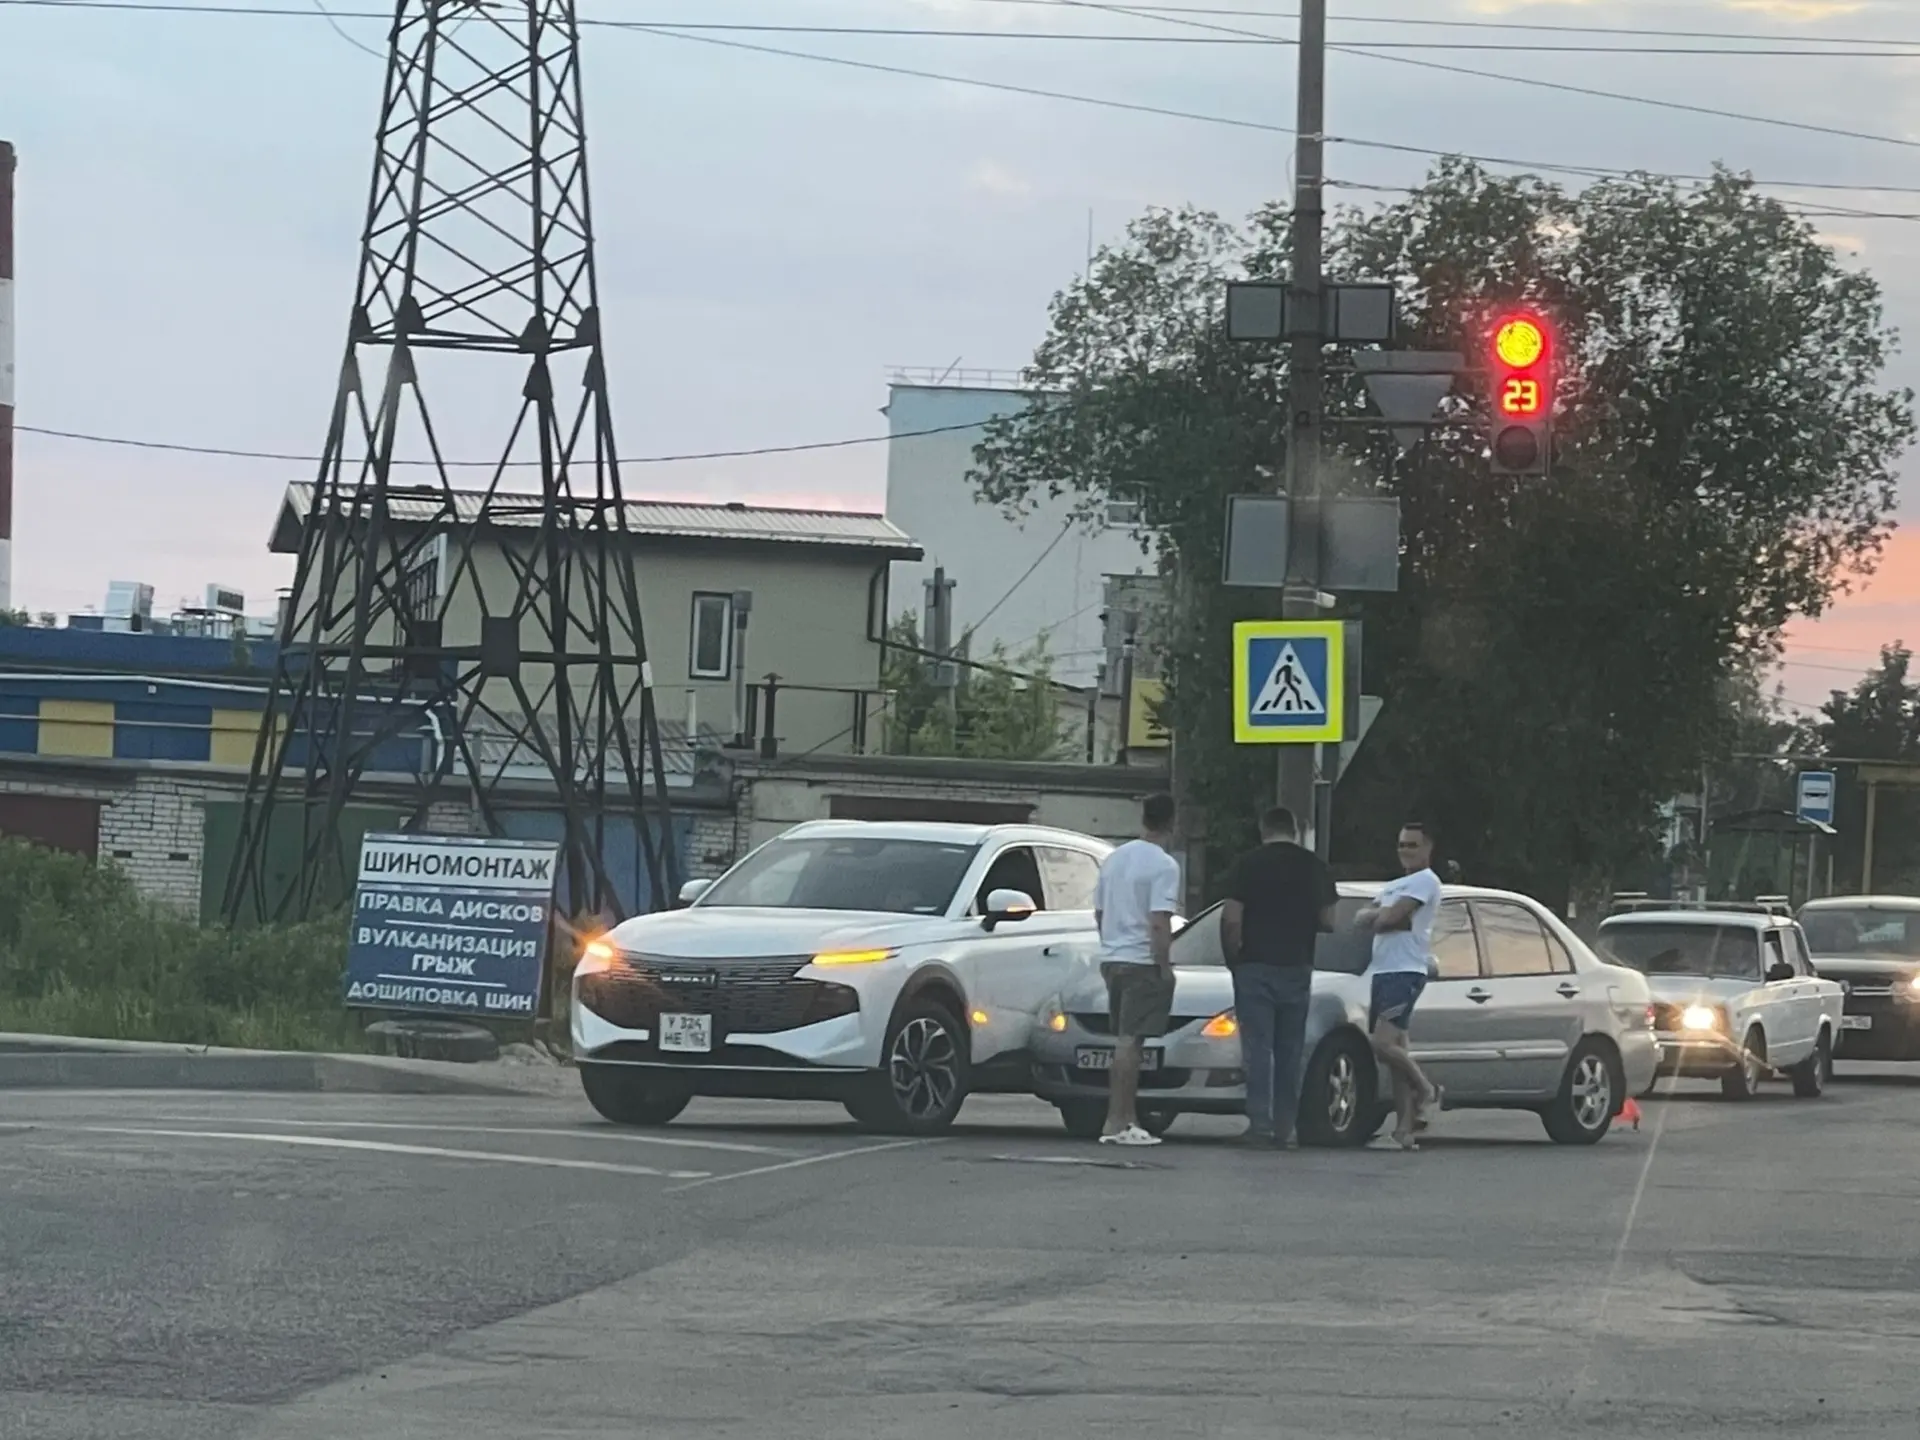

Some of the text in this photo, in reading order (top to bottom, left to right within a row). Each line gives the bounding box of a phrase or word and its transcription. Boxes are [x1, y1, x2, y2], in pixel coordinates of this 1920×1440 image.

[1503, 379, 1537, 412] 23
[364, 851, 549, 880] ШИНОМОНТАЖ
[359, 892, 543, 923] ПРАВКА ДИСКОВ
[358, 927, 536, 958] ВУЛКАНИЗАЦИЯ
[411, 954, 476, 976] ГРЫЖ
[347, 981, 532, 1011] ДОШИПОВКА ШИН
